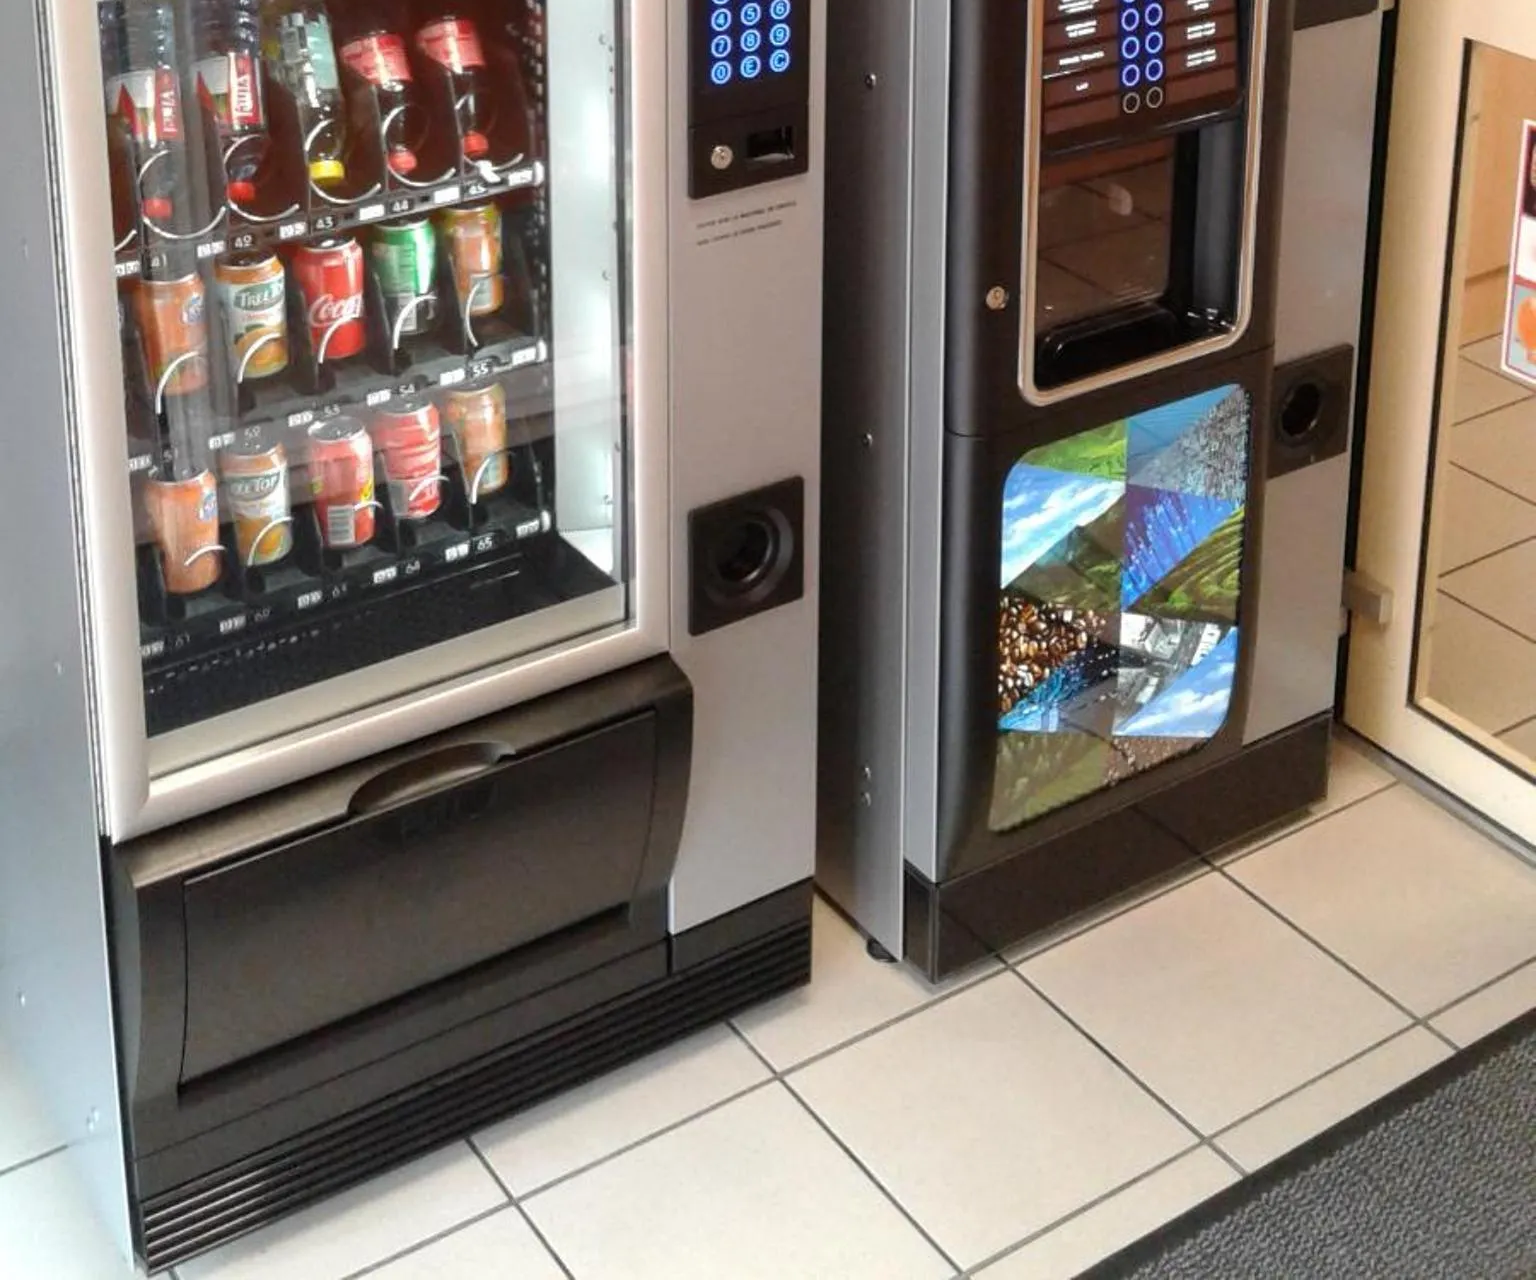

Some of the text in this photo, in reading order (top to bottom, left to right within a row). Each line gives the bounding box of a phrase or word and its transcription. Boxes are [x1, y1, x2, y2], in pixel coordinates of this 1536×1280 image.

[393, 199, 410, 213] 44
[472, 362, 489, 378] 55
[477, 536, 493, 551] 65
